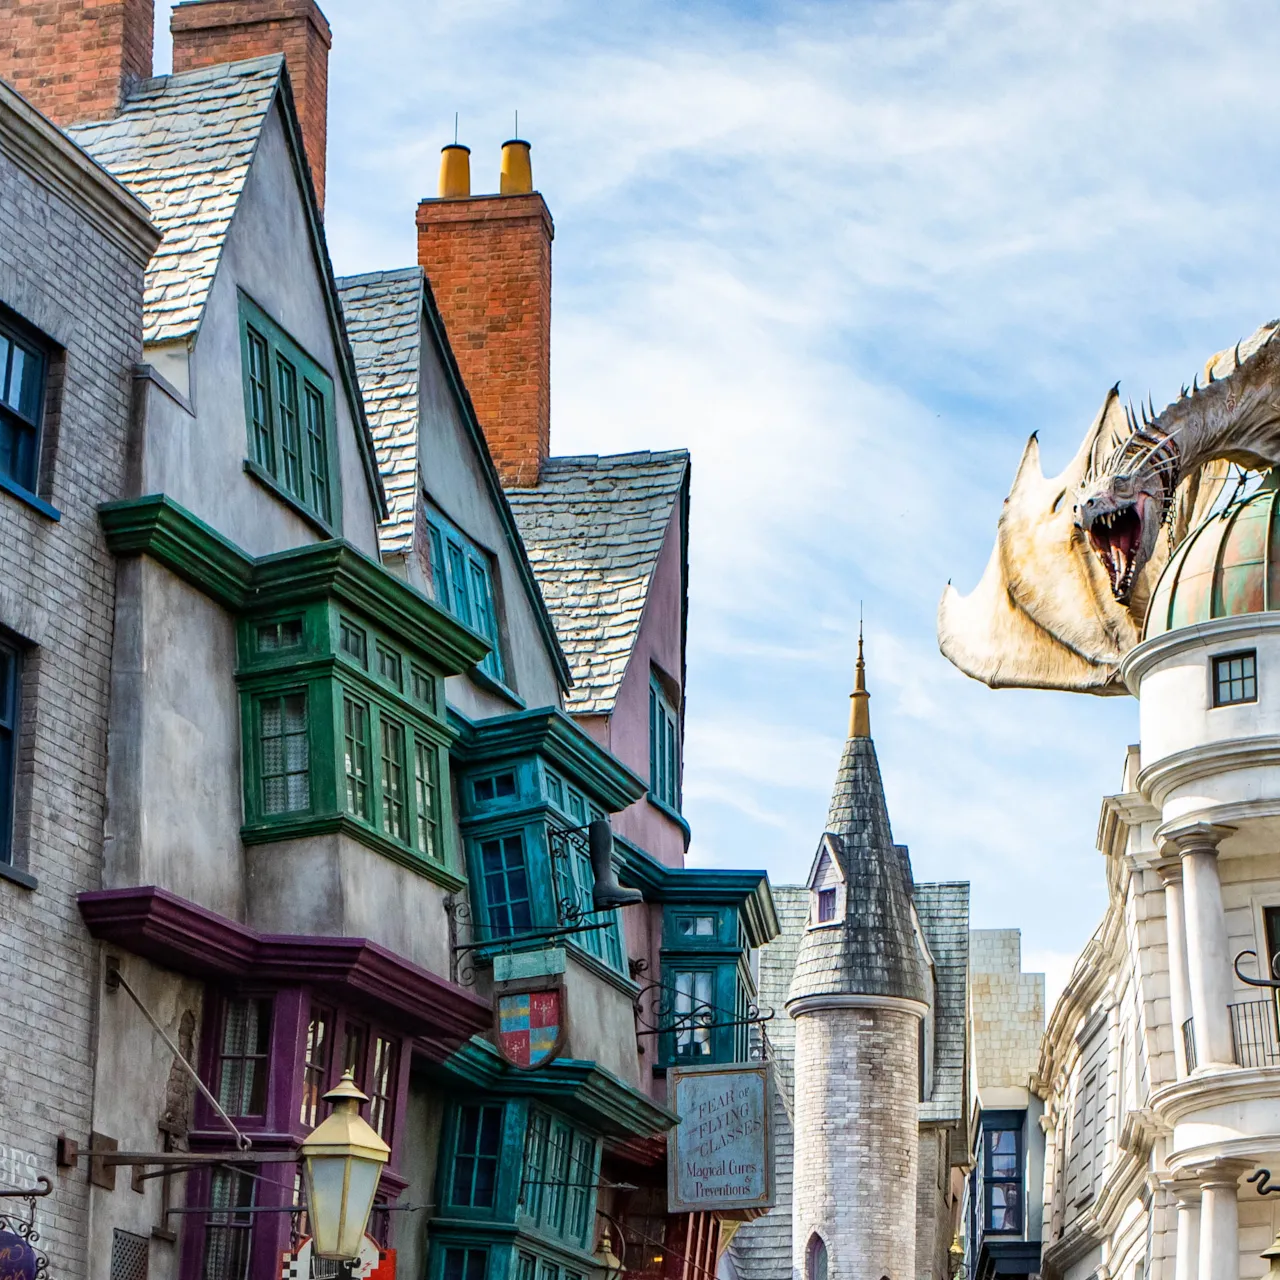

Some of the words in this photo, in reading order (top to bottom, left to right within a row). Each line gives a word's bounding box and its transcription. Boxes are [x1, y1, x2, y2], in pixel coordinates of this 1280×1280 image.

[697, 1089, 735, 1121] FEAR
[697, 1102, 750, 1140] FLYING
[686, 1159, 727, 1182] Magical
[728, 1160, 758, 1176] Cures
[744, 1175, 753, 1184] &
[694, 1181, 752, 1198] Preventions
